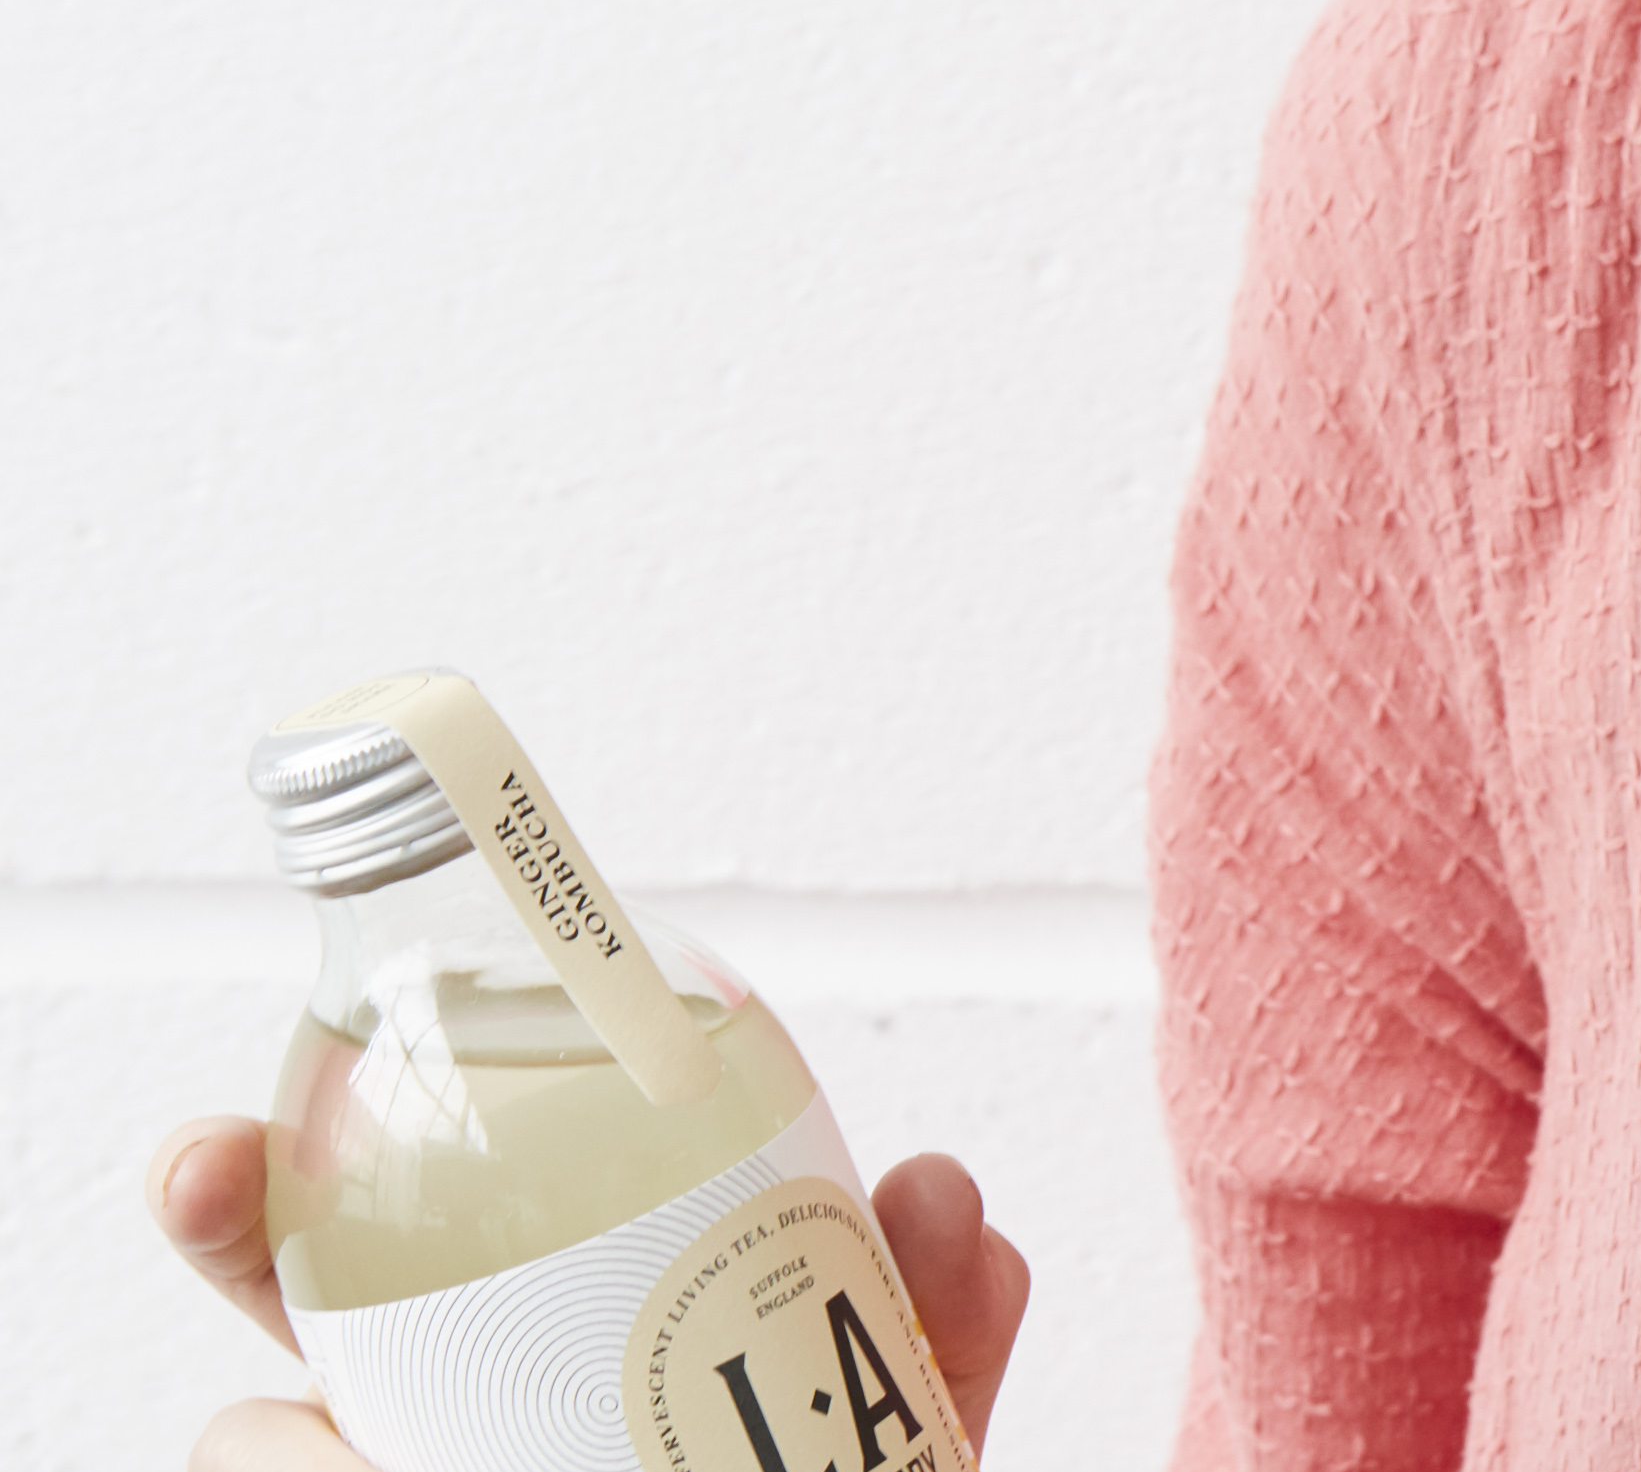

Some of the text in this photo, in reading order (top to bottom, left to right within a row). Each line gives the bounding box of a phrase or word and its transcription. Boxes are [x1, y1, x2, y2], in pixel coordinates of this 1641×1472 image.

[494, 814, 580, 944] GINGER
[500, 769, 624, 961] KOMBUCHA
[667, 1253, 728, 1323] LIVING
[730, 1224, 774, 1257] TEA,
[749, 1255, 808, 1300] SUFFOLK
[756, 1274, 815, 1320] ENGLAND
